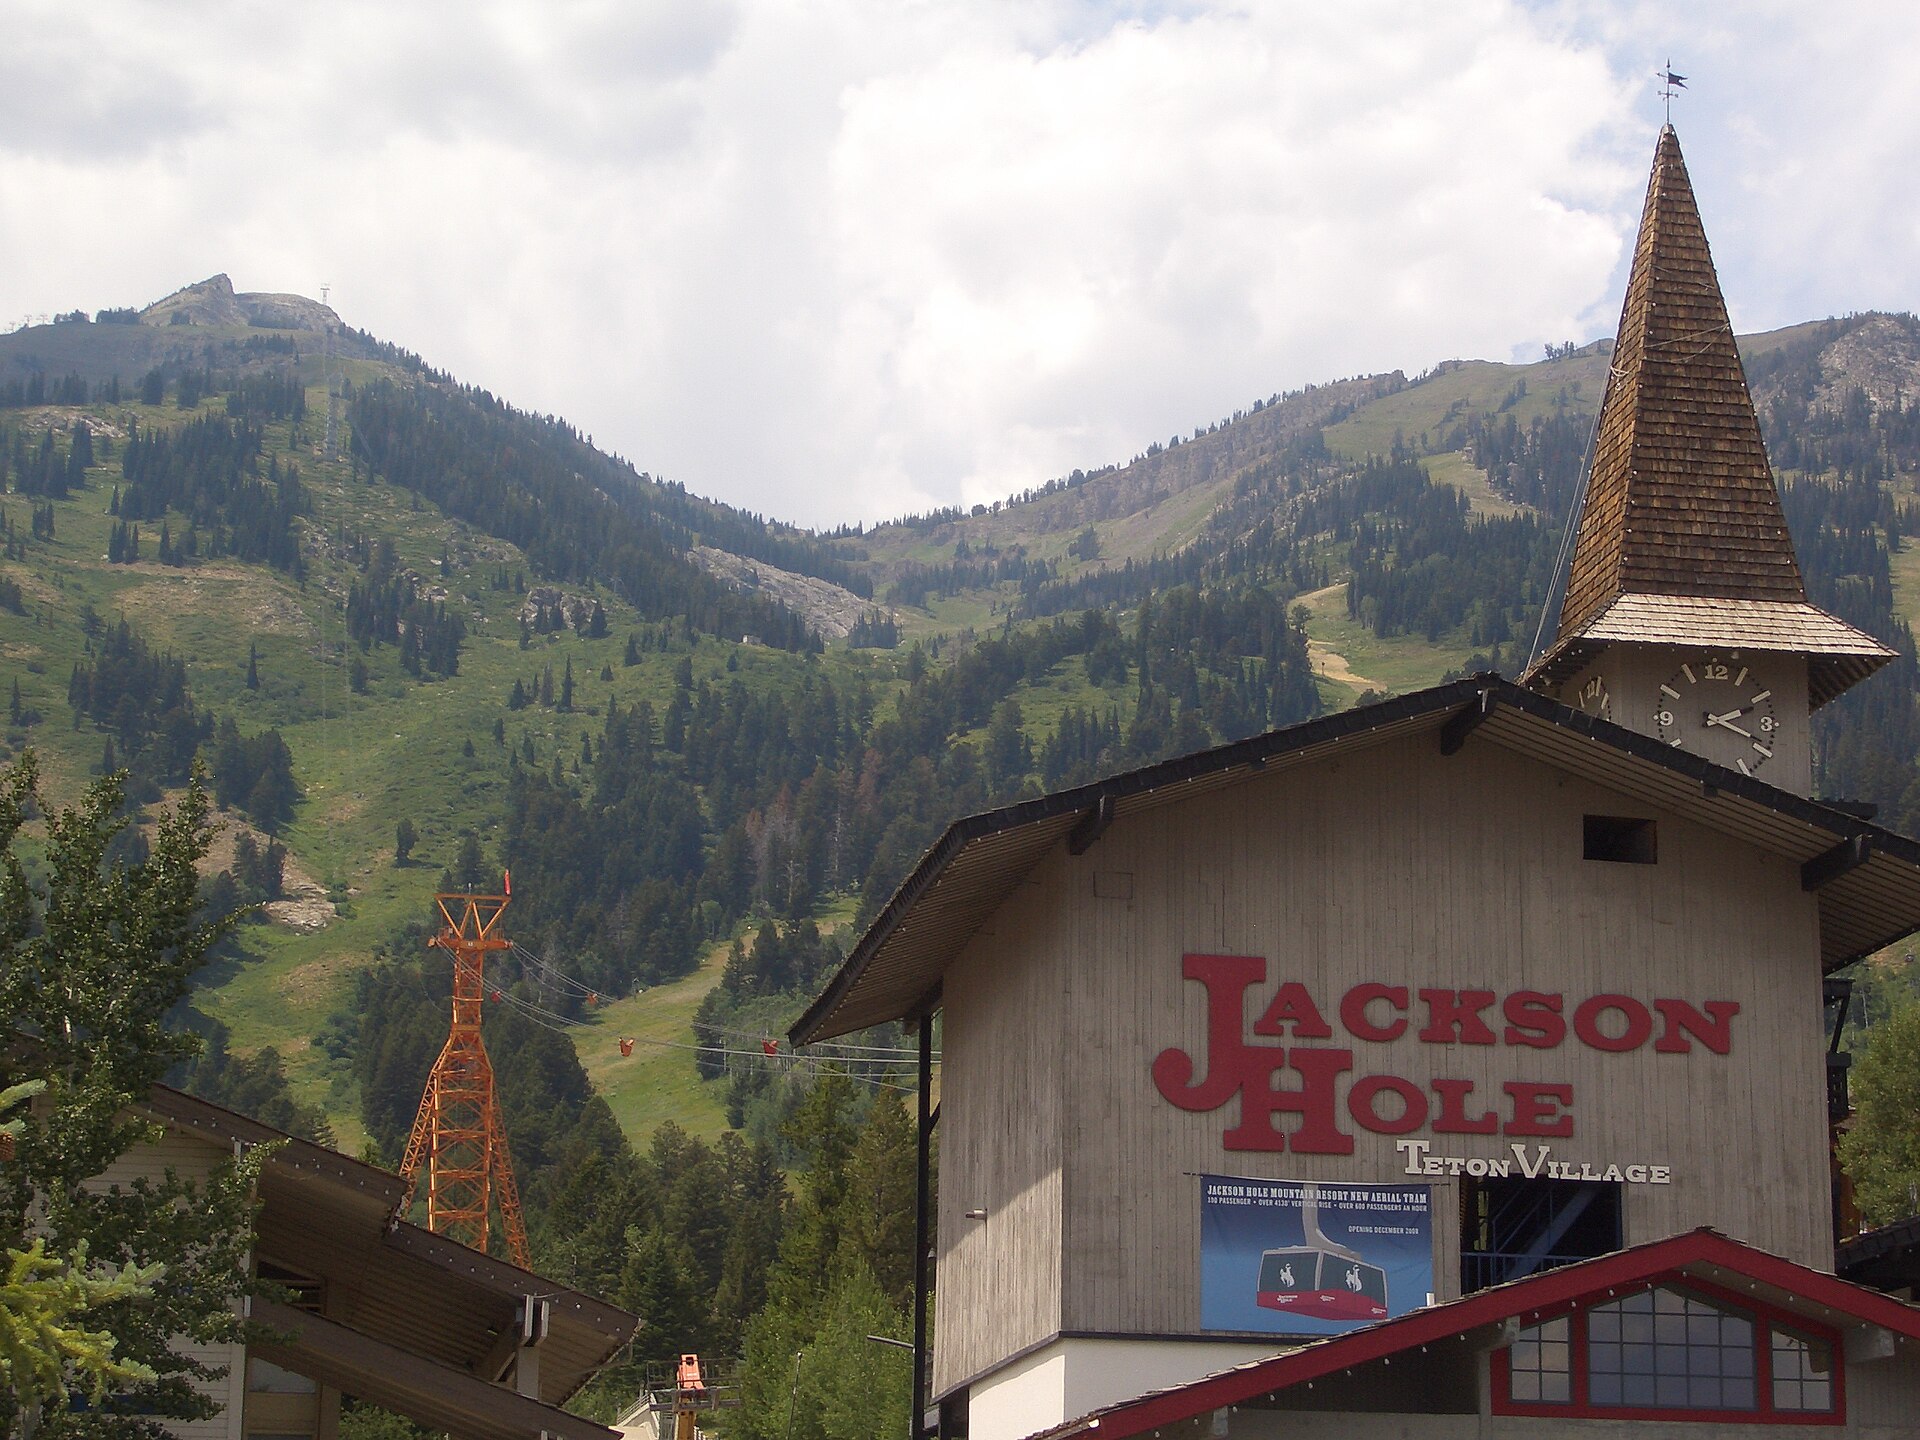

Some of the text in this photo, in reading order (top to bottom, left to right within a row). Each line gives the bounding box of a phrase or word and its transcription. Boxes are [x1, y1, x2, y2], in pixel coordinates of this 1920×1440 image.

[1704, 664, 1728, 680] 12
[1659, 710, 1674, 726] 9
[1760, 716, 1773, 732] 3
[1151, 953, 1741, 1112] JACKSON
[1223, 1046, 1574, 1155] HOLE
[1396, 1139, 1671, 1184] TETON VILLAGE
[1207, 1184, 1427, 1204] JACKSON HOLE MOUNTAIN RESORT NEW AERIAL TRAM
[1219, 1197, 1251, 1205] PASSENGER
[1366, 1203, 1402, 1211] PASSENGERS
[1348, 1225, 1373, 1233] OPENING
[1374, 1226, 1404, 1234] DECEMBER
